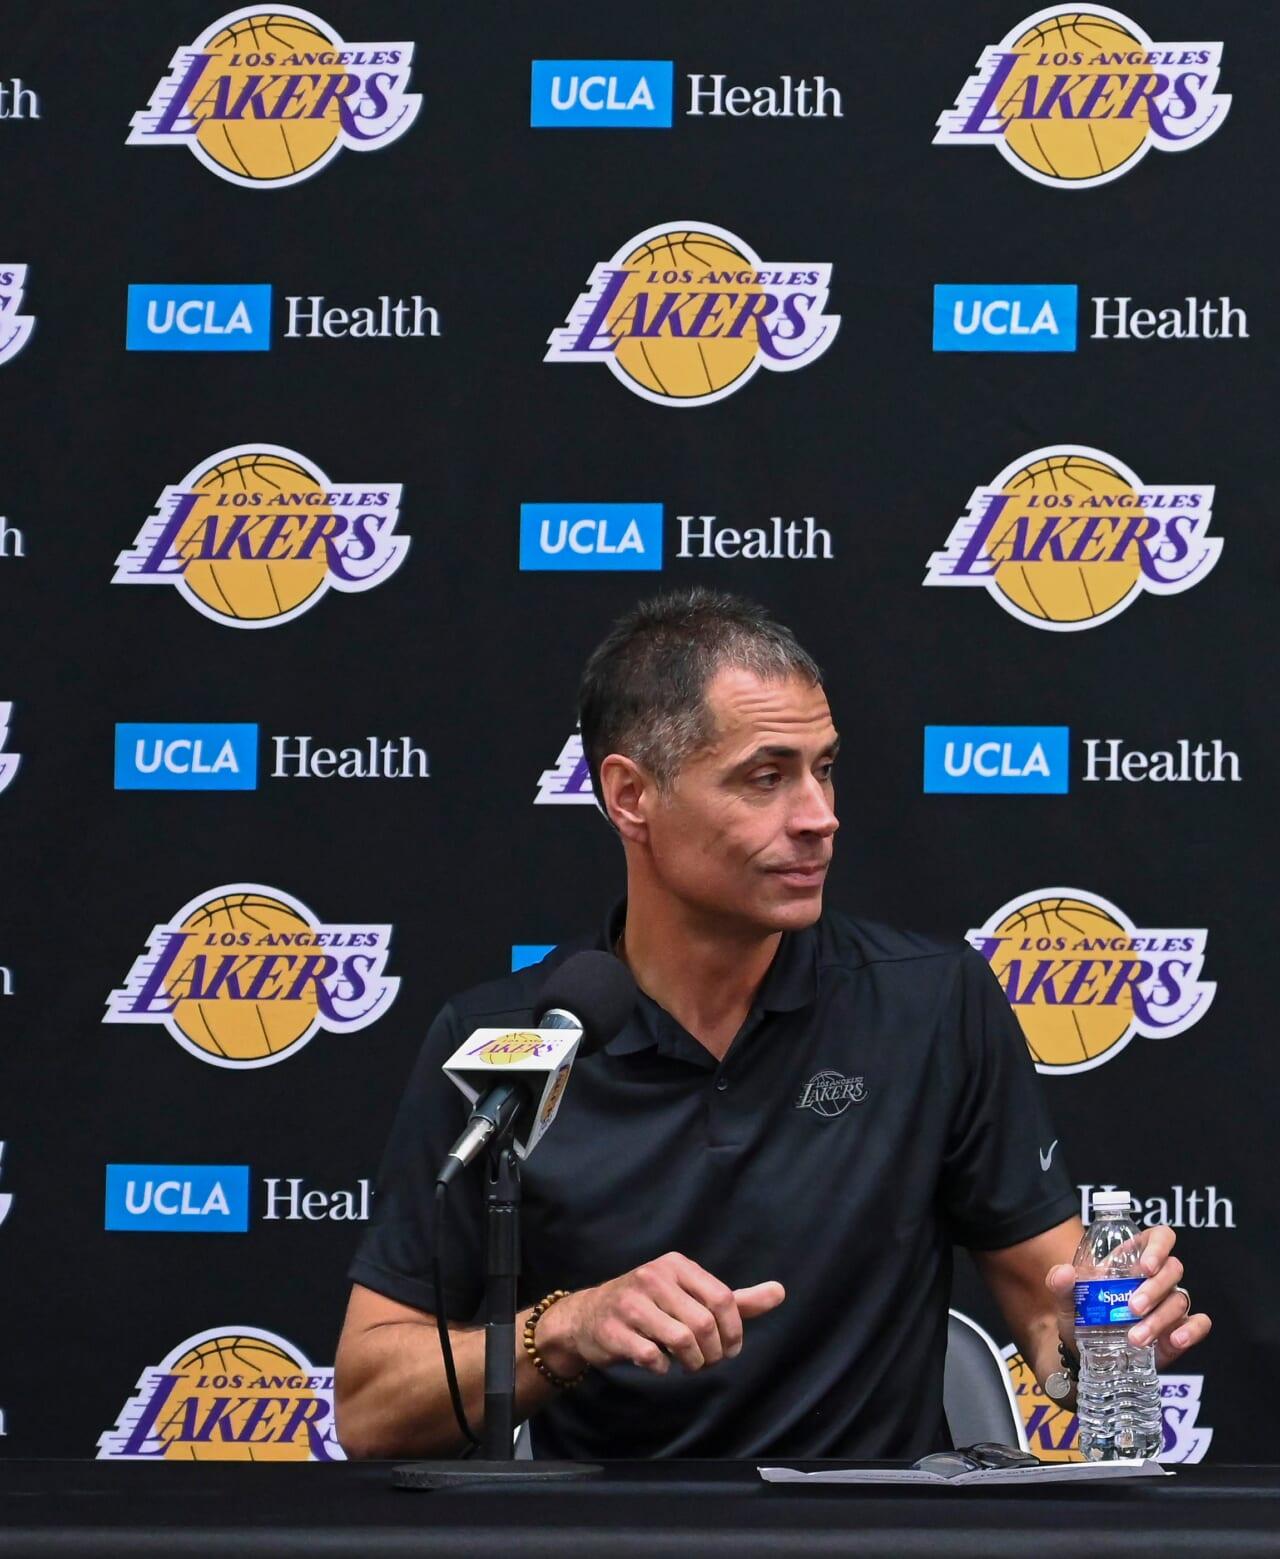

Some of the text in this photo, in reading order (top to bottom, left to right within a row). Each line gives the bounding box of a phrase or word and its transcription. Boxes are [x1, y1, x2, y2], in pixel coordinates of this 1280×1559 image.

[229, 50, 402, 66] LOS ANGELES
[1037, 50, 1211, 65] LOS ANGELES
[141, 53, 410, 139] LAKERS
[551, 74, 843, 117] UCLA Health
[949, 52, 1218, 140] LAKERS
[647, 270, 820, 284] LOS ANGELES
[147, 296, 440, 337] UCLA Health
[559, 270, 827, 360] LAKERS
[953, 297, 1249, 339] UCLA Health
[216, 492, 390, 506] LOS ANGELES
[1027, 493, 1202, 508] LOS ANGELES
[128, 493, 397, 581] LAKERS
[540, 516, 833, 558] UCLA Health
[939, 494, 1210, 583] LAKERS
[135, 736, 429, 778] UCLA Health
[944, 739, 1241, 781] UCLA Health
[205, 932, 379, 946] LOS ANGELES
[1020, 936, 1195, 951] LOS ANGELES
[117, 932, 387, 1022] LAKERS
[975, 937, 1203, 1028] AKERS
[796, 1083, 868, 1108] LAKERS
[125, 1178, 369, 1220] UCLA Heal
[1103, 1289, 1132, 1306] Spar
[197, 1374, 335, 1390] LOS ANGEL
[1016, 1382, 1043, 1396] LO
[109, 1374, 340, 1461] LAKER
